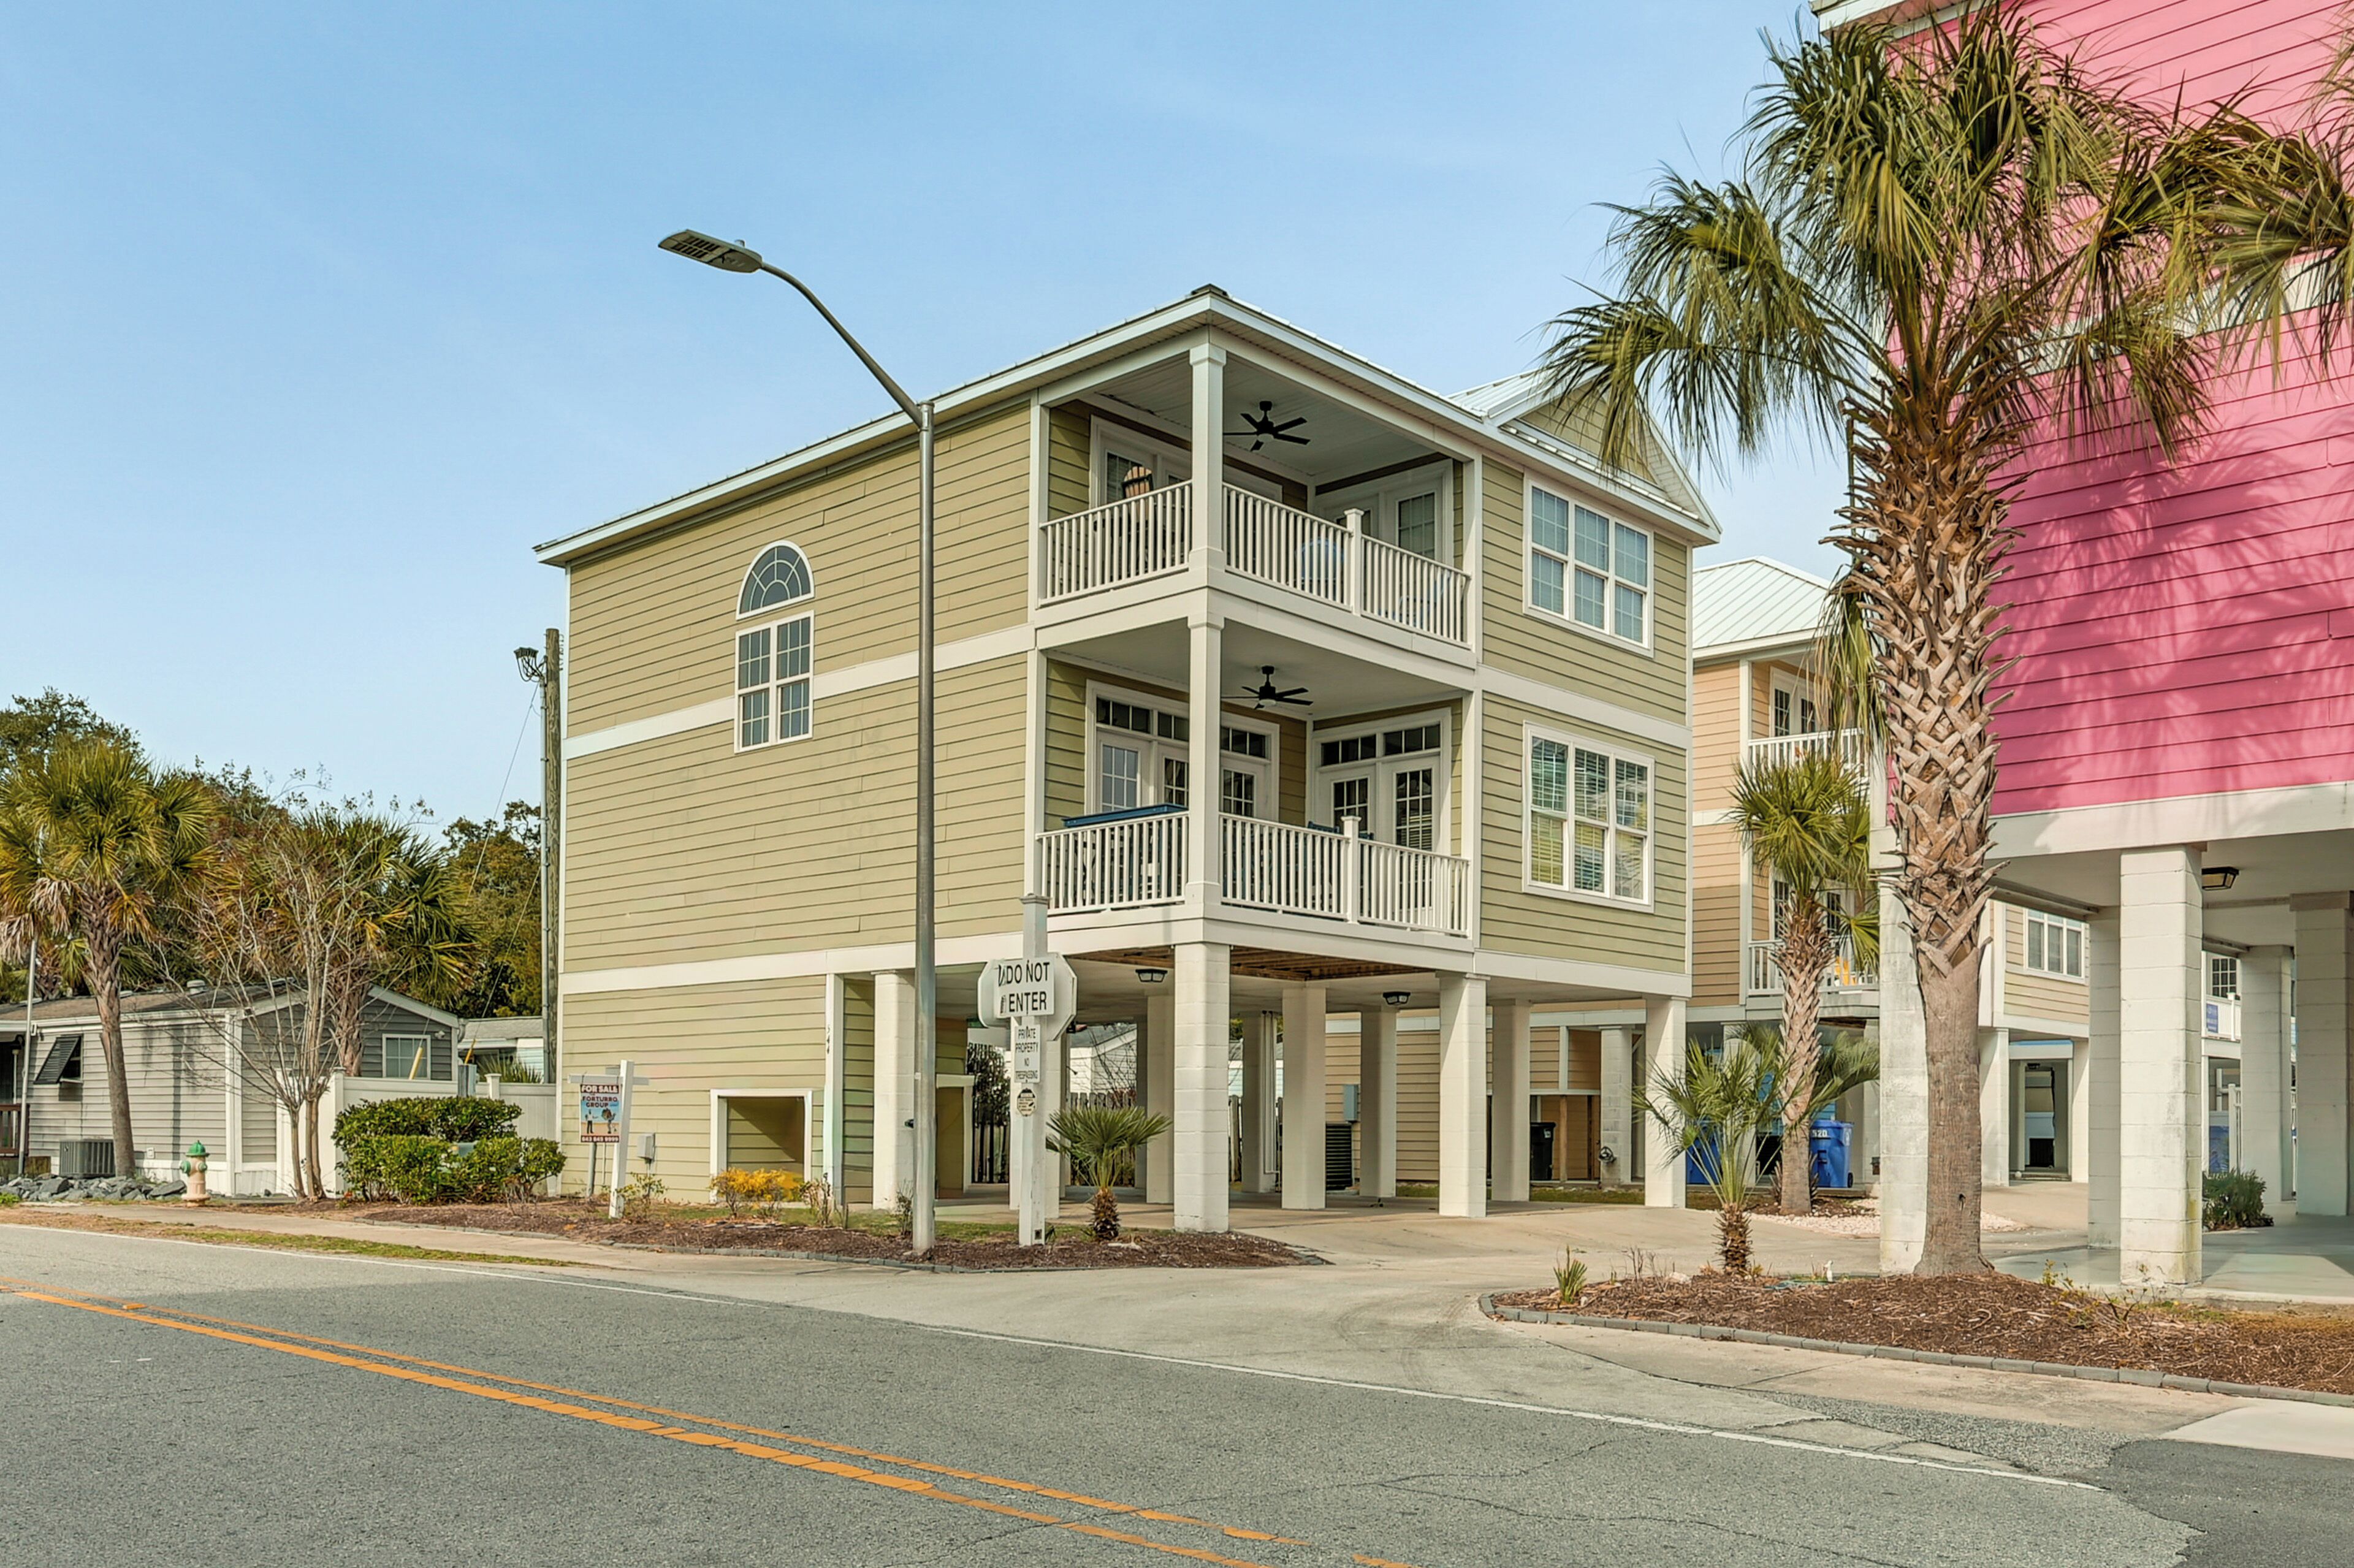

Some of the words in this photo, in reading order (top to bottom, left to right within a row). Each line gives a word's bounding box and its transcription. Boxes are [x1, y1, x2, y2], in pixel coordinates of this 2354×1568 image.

[1006, 964, 1023, 984] DO
[1026, 962, 1050, 983] NOT
[1008, 991, 1047, 1013] ENTER
[1018, 1028, 1036, 1039] PRIVATE
[1015, 1042, 1038, 1052] PROPERTY
